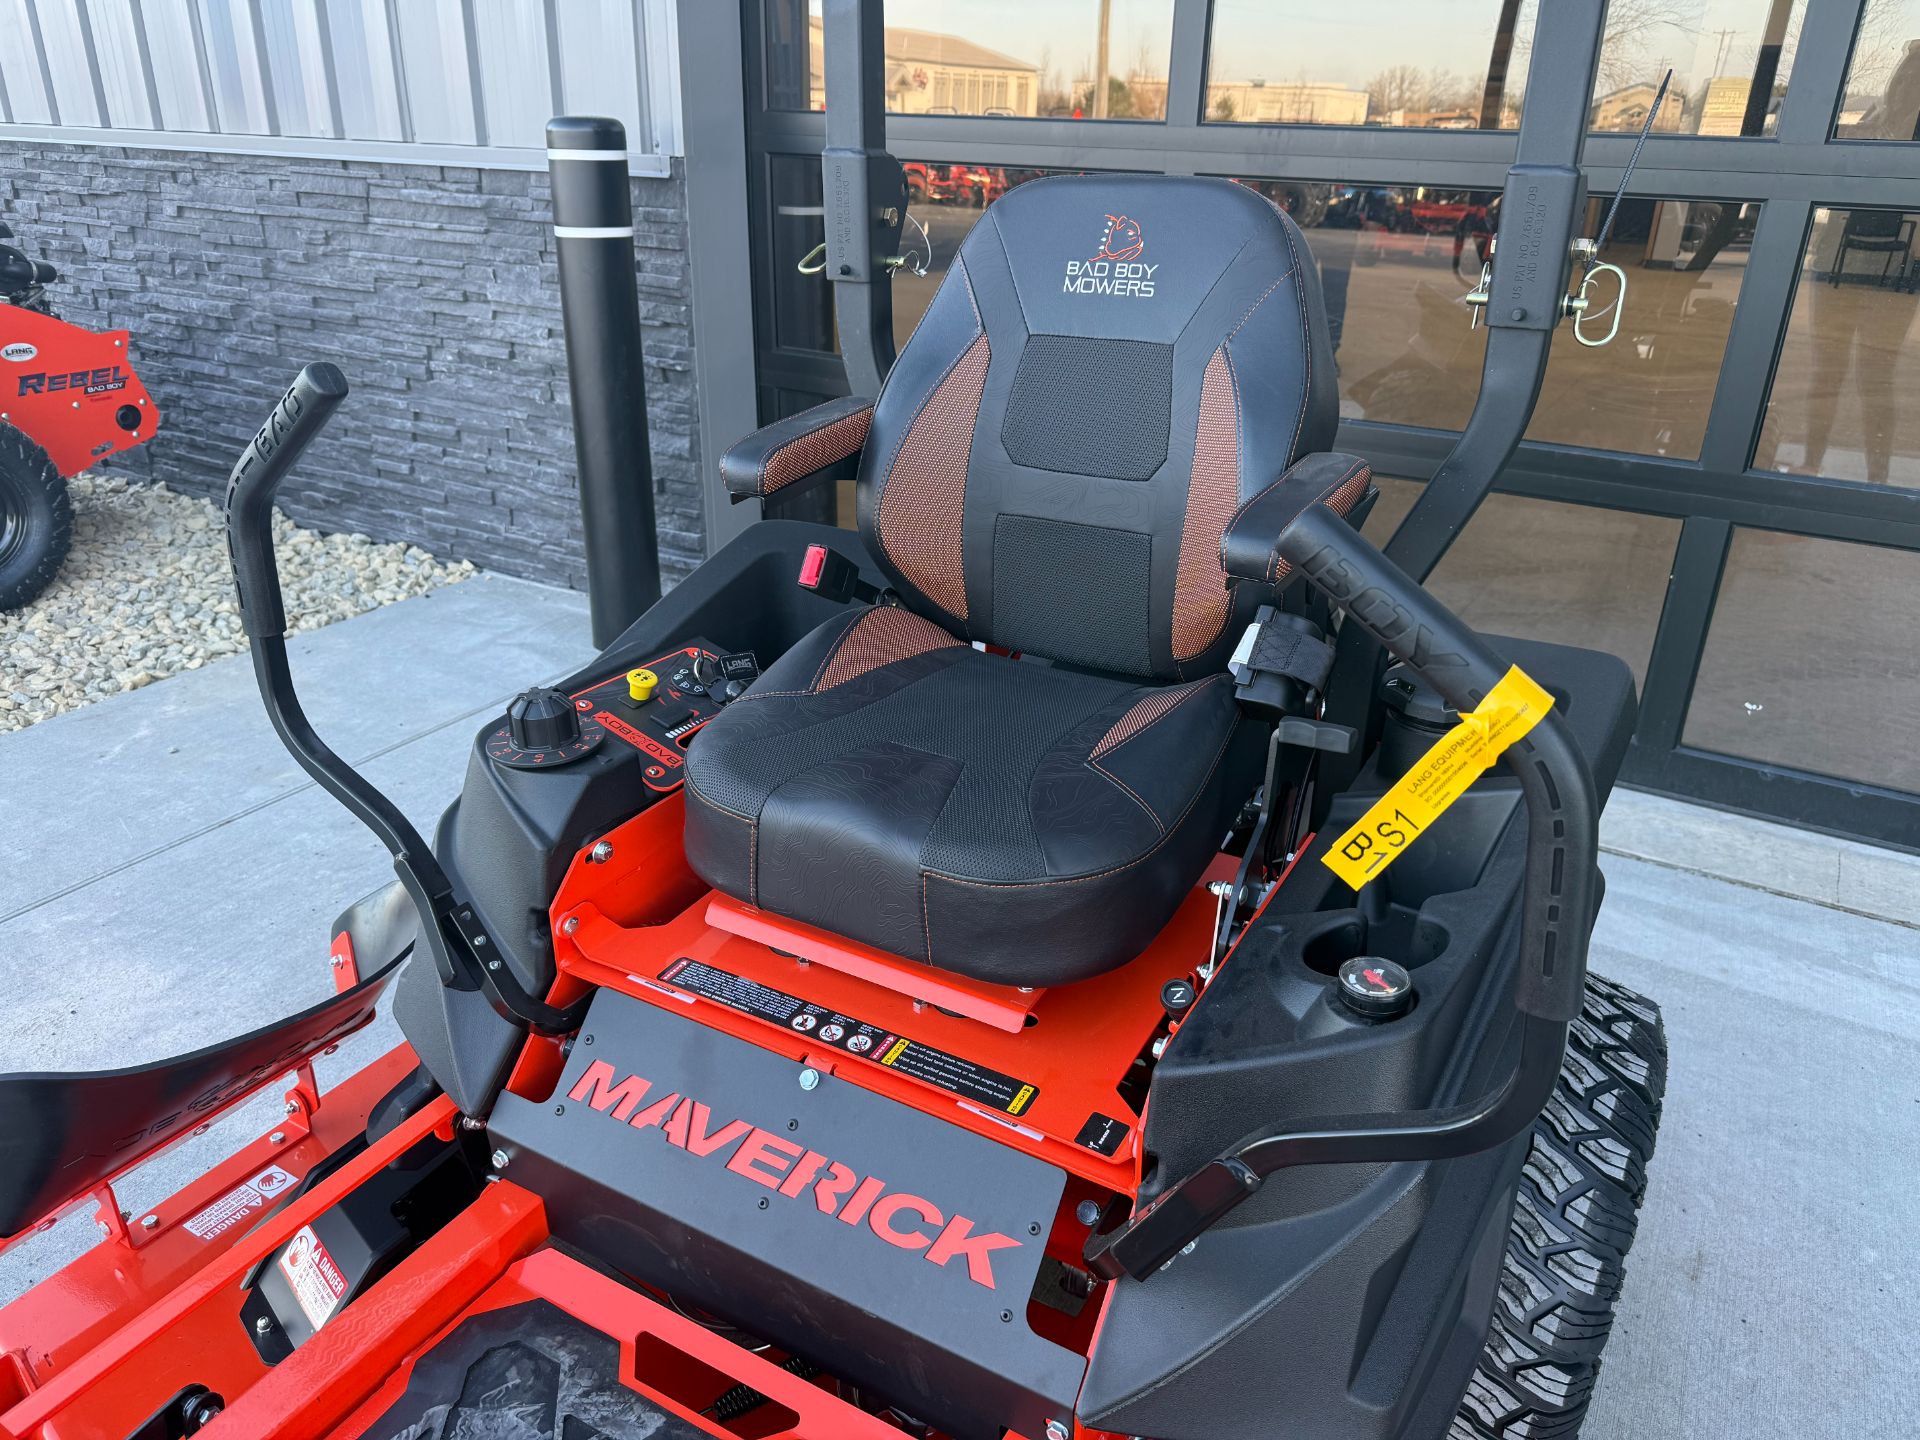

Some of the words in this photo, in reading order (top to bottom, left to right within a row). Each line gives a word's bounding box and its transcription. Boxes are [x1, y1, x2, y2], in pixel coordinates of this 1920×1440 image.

[1067, 261, 1109, 276] BAD
[1115, 263, 1159, 279] BOY
[1514, 259, 1525, 282] PAT
[1526, 261, 1538, 283] AND
[1064, 276, 1155, 297] MOWERS
[1512, 286, 1522, 300] US
[5, 347, 33, 357] LANG
[18, 366, 129, 396] REBEL
[87, 385, 104, 393] BAD
[107, 382, 123, 390] BOY
[726, 658, 752, 671] LANG
[598, 715, 632, 735] BOY
[646, 743, 680, 766] BAD
[1406, 768, 1432, 794] LANG
[1377, 808, 1419, 847] S1
[567, 1059, 1024, 1290] MAVERICK
[202, 1206, 250, 1241] DANGER
[319, 1256, 346, 1296] DANGER
